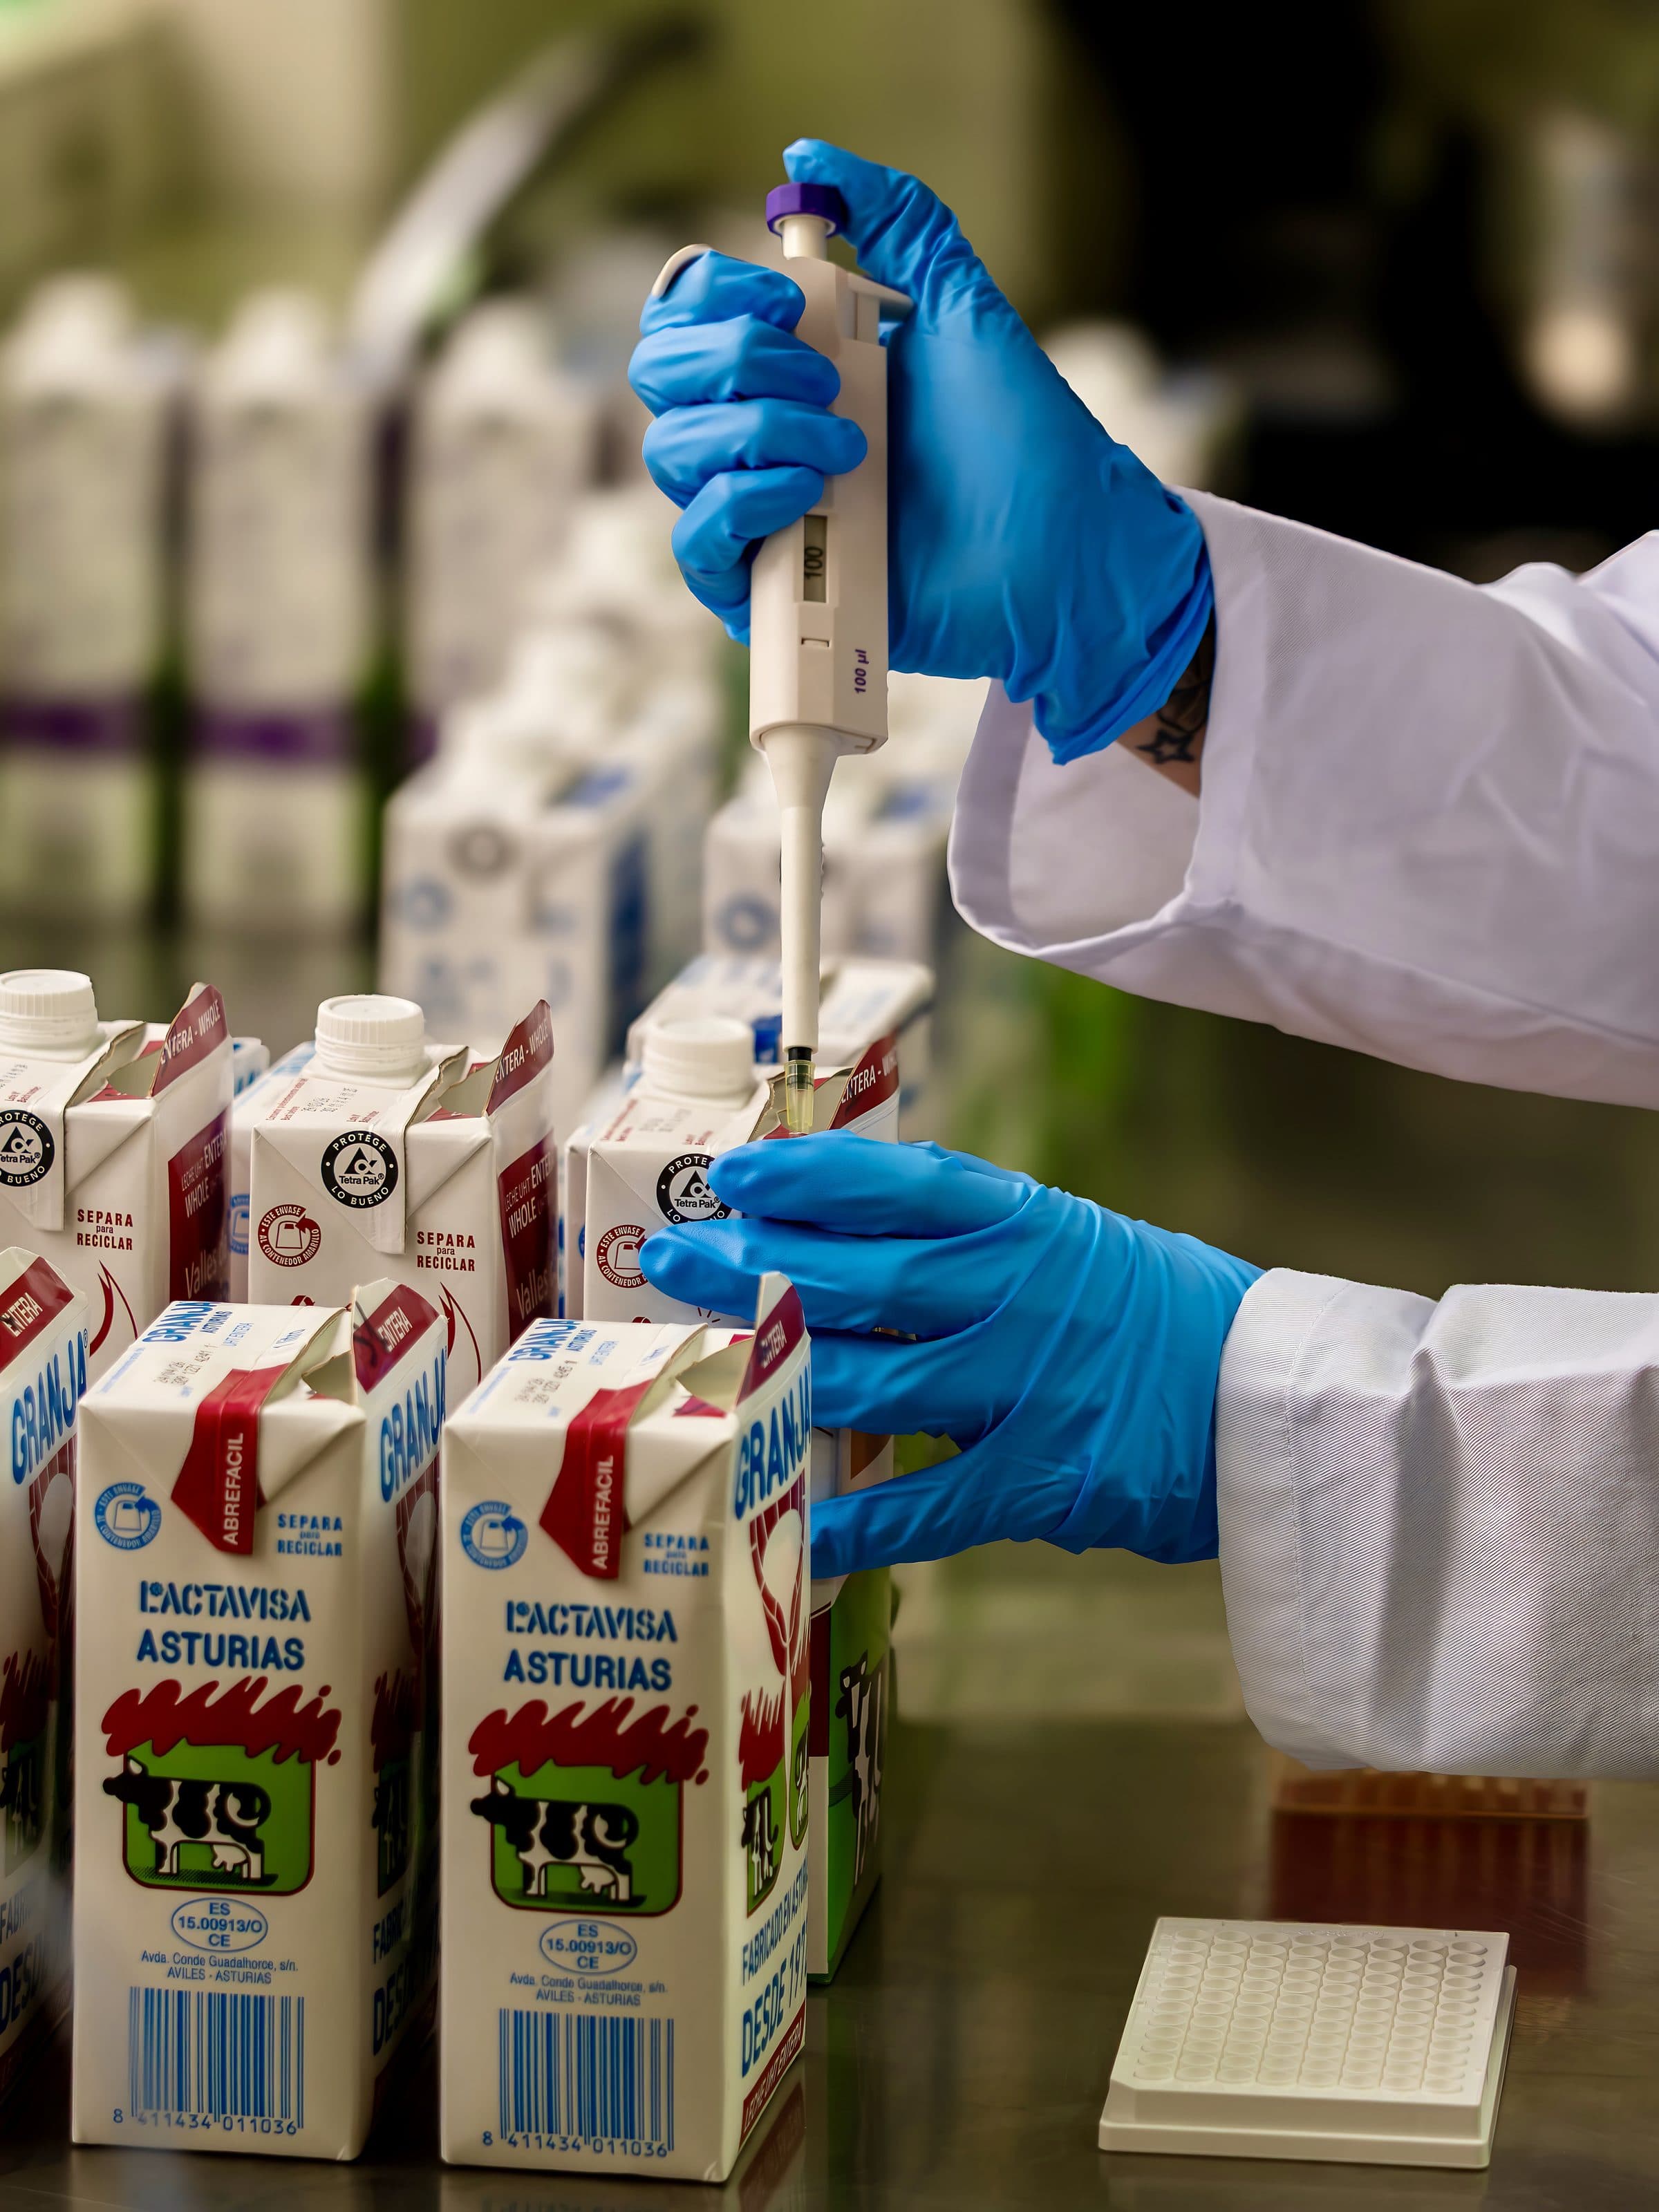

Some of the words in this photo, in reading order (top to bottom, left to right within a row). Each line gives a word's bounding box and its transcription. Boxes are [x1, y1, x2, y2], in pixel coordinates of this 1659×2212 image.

[804, 545, 823, 579] 100
[854, 668, 867, 694] 100
[198, 999, 221, 1036] WHOLE
[529, 1018, 548, 1056] WHOLE
[332, 1133, 387, 1152] PROTEGE
[7, 1165, 45, 1184] BUENO
[668, 1156, 713, 1174] PROTE
[339, 1175, 362, 1185] Tetra
[518, 1177, 530, 1199] UHT
[185, 1177, 209, 1219] WHOLE
[332, 1185, 346, 1199] LO
[350, 1187, 389, 1206] BUENO
[675, 1198, 697, 1208] Tetra
[77, 1209, 133, 1227] SEPARA
[261, 1212, 276, 1228] ESTE
[276, 1206, 301, 1216] ENVASE
[509, 1197, 537, 1239] WHOLE
[667, 1209, 681, 1222] LO
[96, 1225, 113, 1233] para
[259, 1235, 268, 1243] AL
[600, 1233, 615, 1248] ESTE
[614, 1226, 641, 1237] ENVASE
[77, 1232, 133, 1250] RECICLAR
[303, 1228, 319, 1260] AMARILLO
[417, 1231, 476, 1248] SEPARA
[262, 1244, 303, 1266] CONTENEDOR
[436, 1247, 456, 1255] para
[417, 1255, 475, 1272] RECICLAR
[598, 1255, 607, 1264] AL
[603, 1265, 642, 1287] CONTENEDOR
[199, 1311, 233, 1333] ASTURIAS
[565, 1329, 598, 1352] ASTURIAS
[223, 1433, 244, 1546] ABREFACIL
[277, 1513, 344, 1532] SEPARA
[592, 1454, 614, 1571] ABREFACIL
[277, 1539, 343, 1556] RECICLAR
[644, 1533, 710, 1551] SEPARA
[643, 1559, 709, 1577] RECICLAR
[140, 1580, 312, 1622] LACTAVISA
[507, 1600, 678, 1643] LACTAVISA
[137, 1629, 305, 1671] ASTURIAS
[503, 1649, 672, 1691] ASTURIAS
[209, 1902, 231, 1916] ES
[208, 1933, 231, 1947] CE
[577, 1924, 599, 1938] ES
[742, 1901, 782, 1986] FABRICADO
[783, 1886, 791, 1936] EN
[141, 1950, 170, 1965] Avda.
[173, 1951, 206, 1967] Conde
[577, 1956, 599, 1969] CE
[167, 1966, 206, 1980] AVILES
[215, 1970, 272, 1985] ASTURIAS
[541, 1974, 574, 1989] Conde
[536, 1988, 574, 2003] AVILES
[584, 1993, 641, 2006] ASTURIAS
[741, 1957, 787, 2078] DESDE
[789, 1911, 808, 2008] 197
[113, 2108, 124, 2123] 8
[138, 2112, 212, 2130] 411434
[223, 2116, 297, 2135] 011036
[482, 2130, 493, 2146] 8
[508, 2133, 581, 2152] 411434
[592, 2138, 668, 2157] 011036
